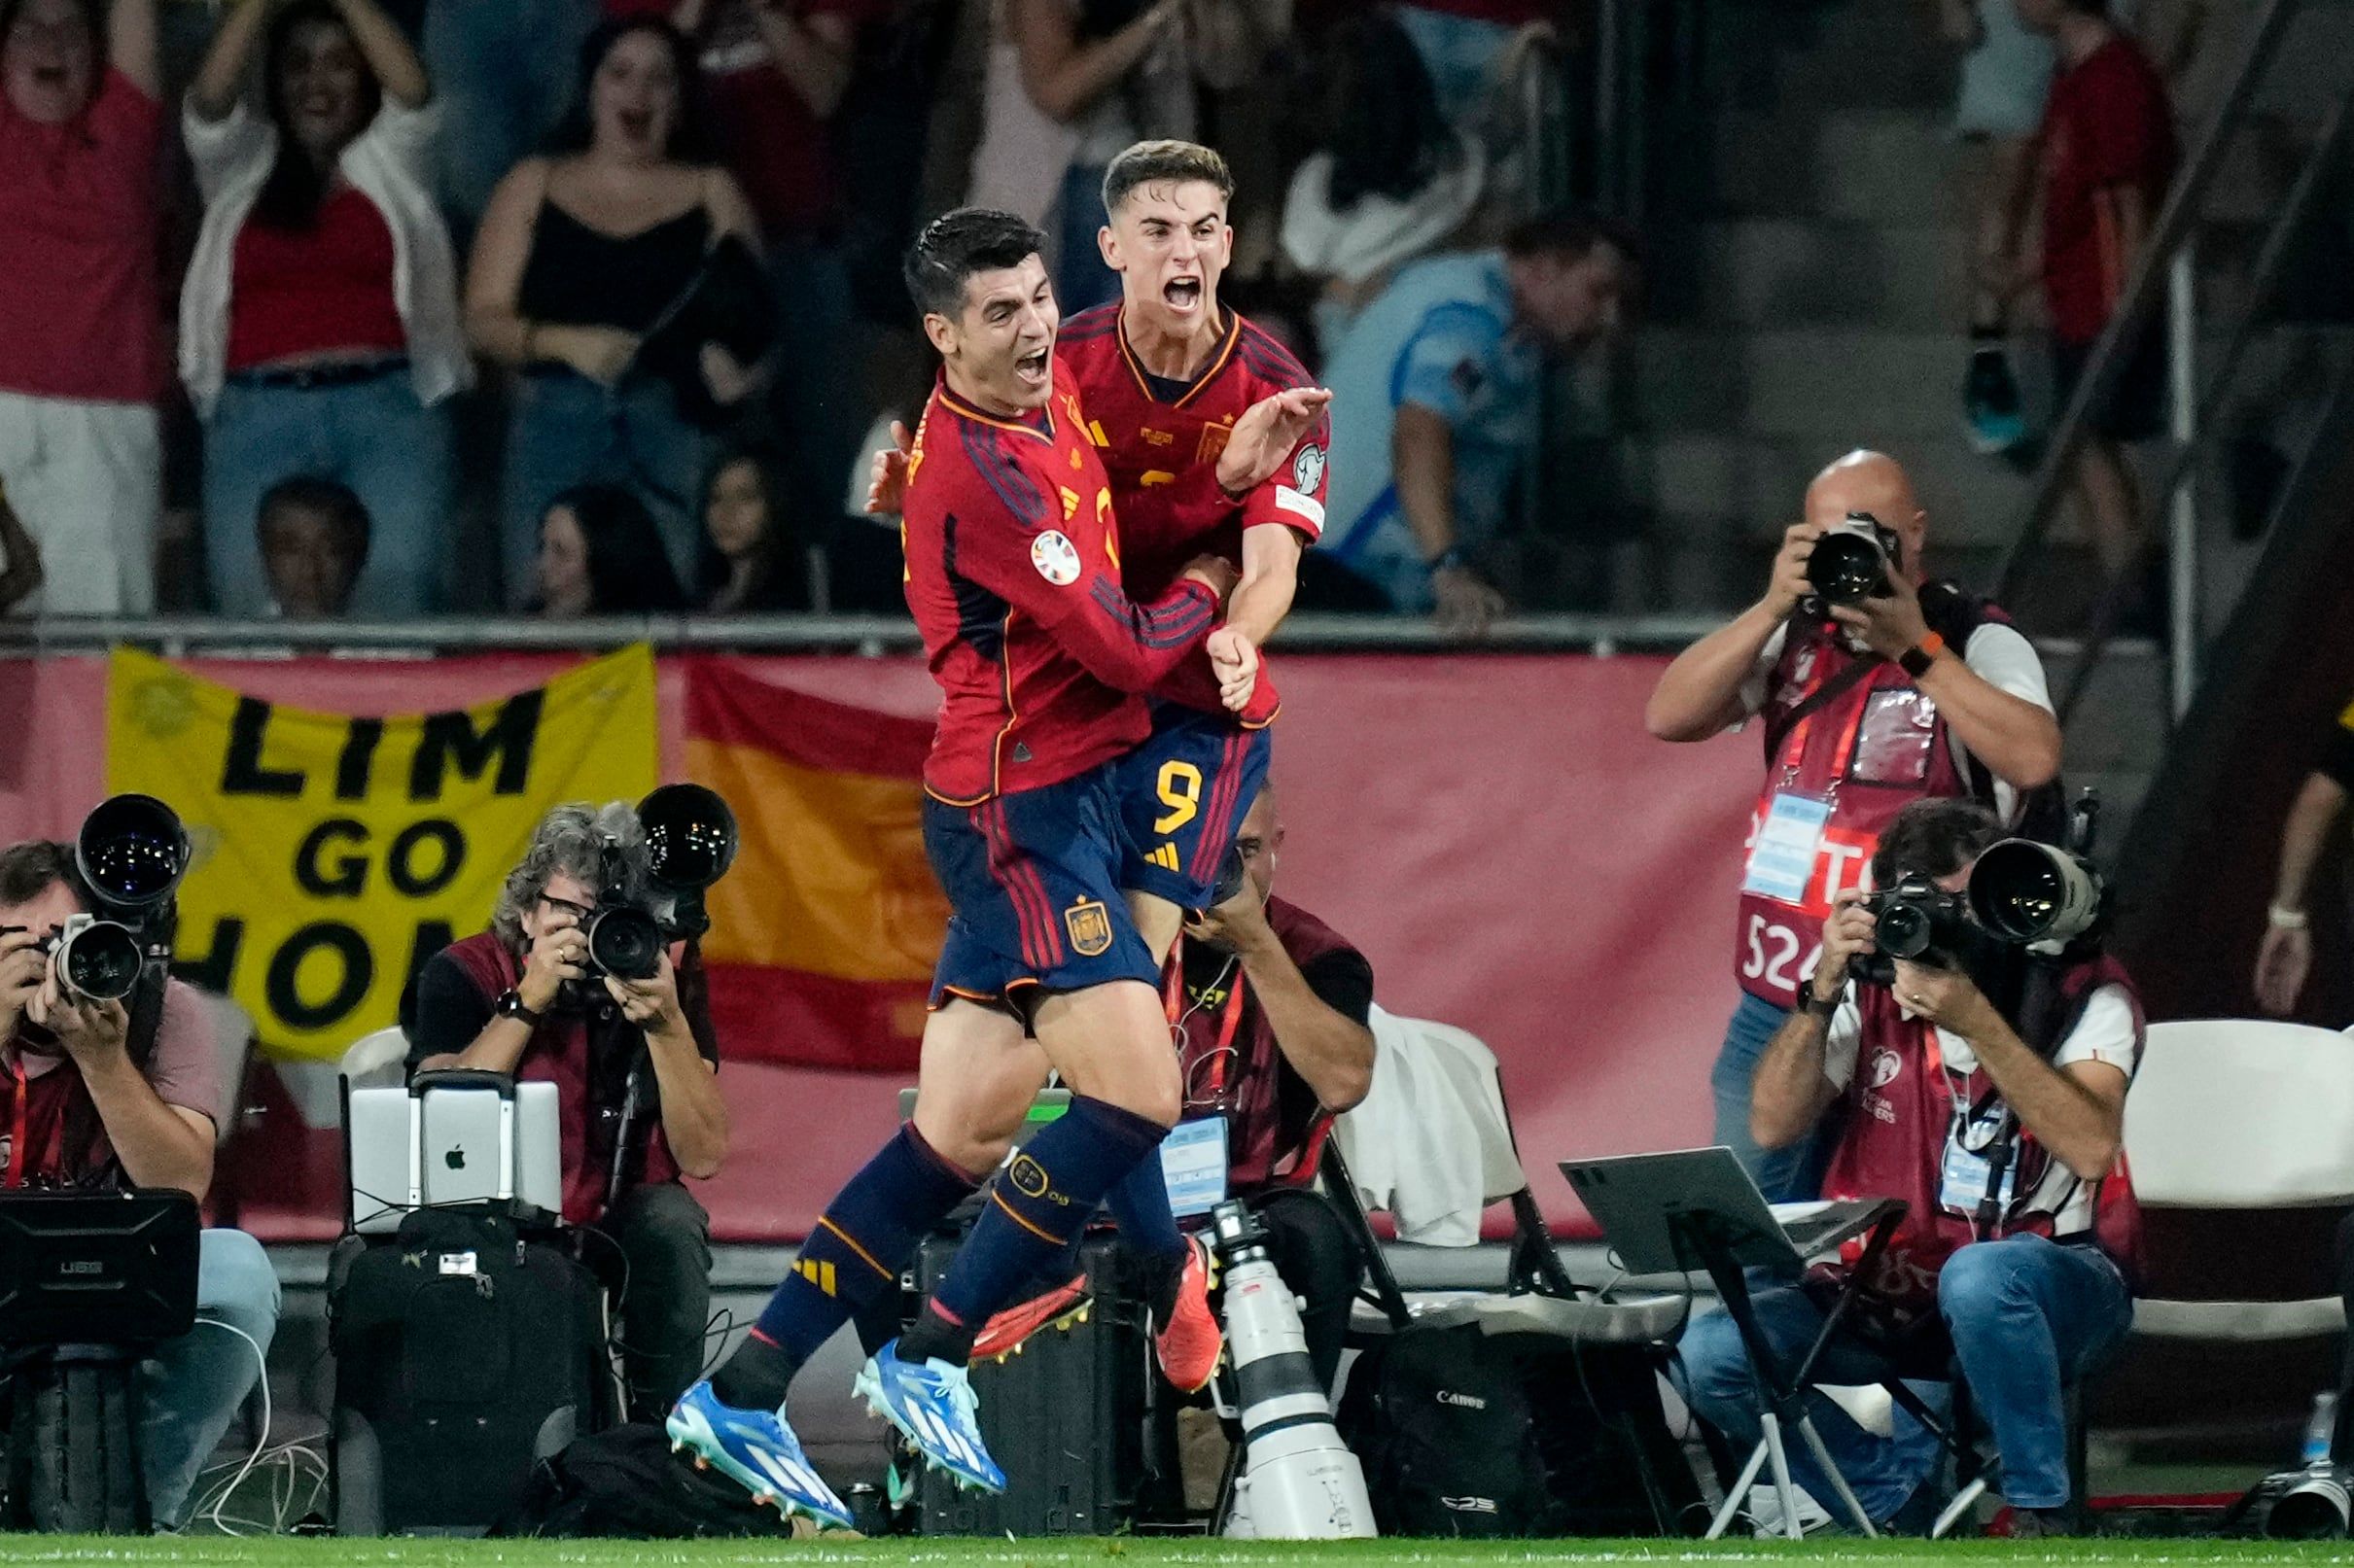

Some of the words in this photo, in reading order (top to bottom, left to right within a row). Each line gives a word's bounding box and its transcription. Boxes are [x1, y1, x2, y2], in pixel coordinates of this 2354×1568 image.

[221, 687, 546, 802] LIM
[1153, 760, 1203, 835] 9
[295, 818, 467, 898] GO
[1436, 1390, 1487, 1410] Canon
